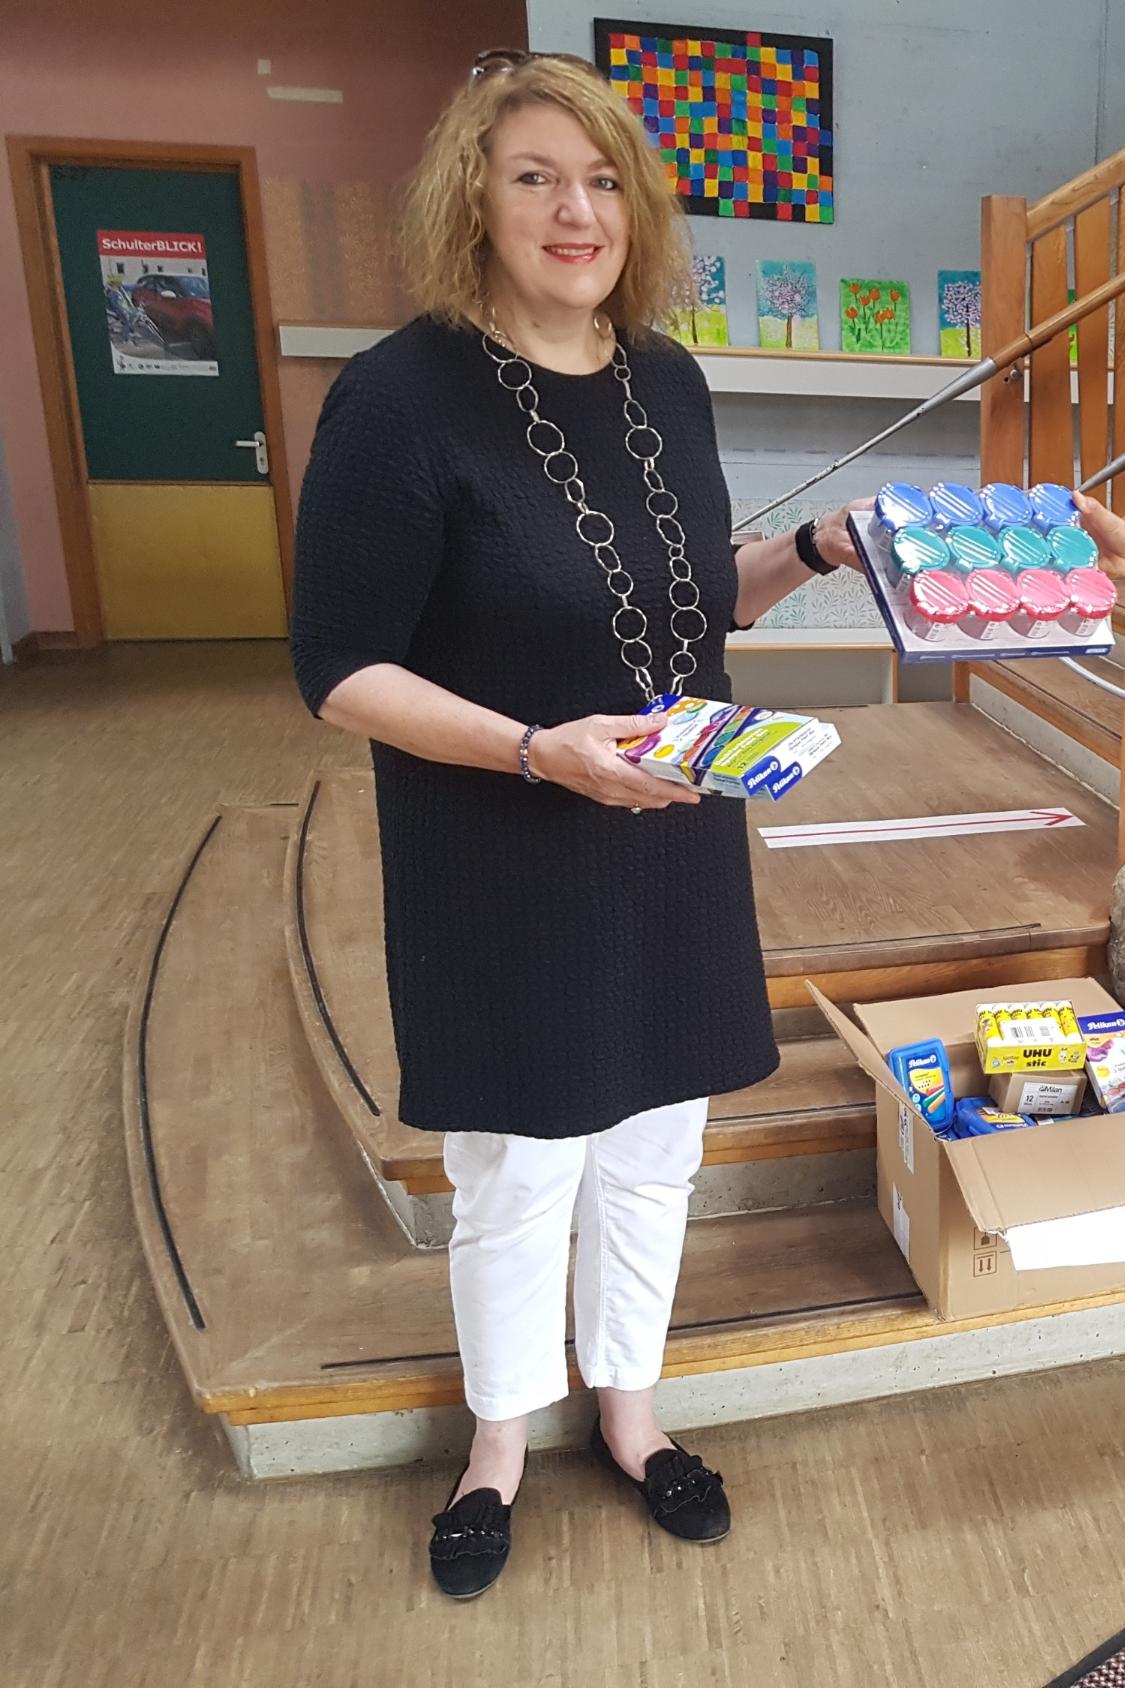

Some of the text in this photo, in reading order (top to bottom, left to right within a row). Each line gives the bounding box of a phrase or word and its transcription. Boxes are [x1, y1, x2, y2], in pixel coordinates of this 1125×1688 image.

[102, 238, 202, 253] SchulterBLICK!
[747, 768, 771, 789] Pelikan
[772, 773, 794, 793] Pelikan
[1087, 1022, 1117, 1031] Pelikan
[1023, 1048, 1052, 1058] UHU
[1026, 1059, 1047, 1067] stic
